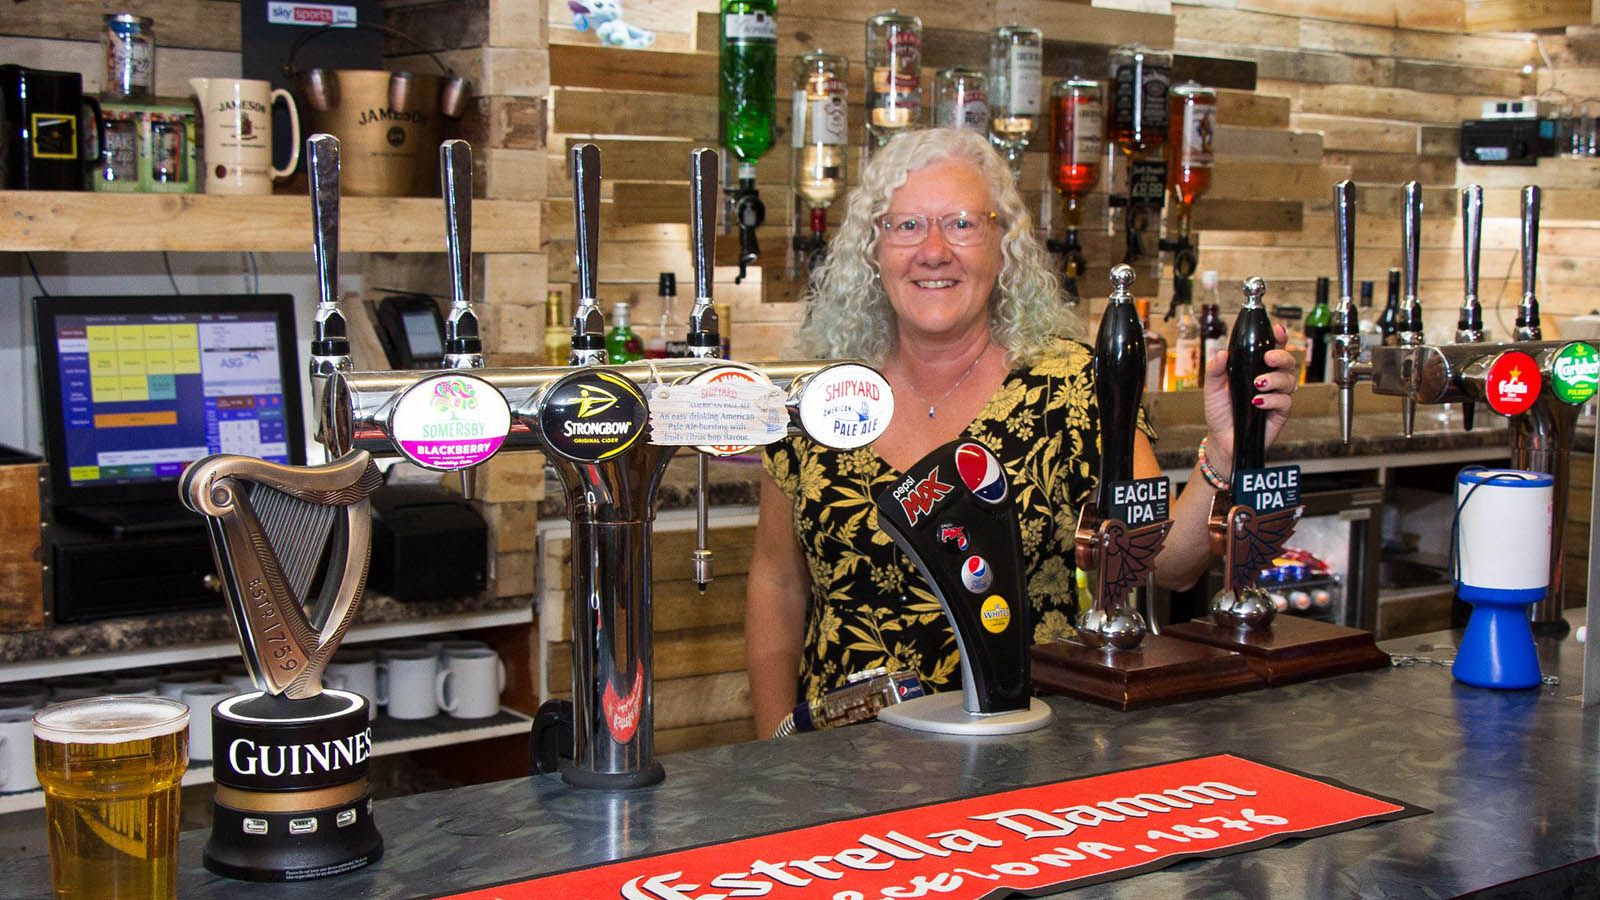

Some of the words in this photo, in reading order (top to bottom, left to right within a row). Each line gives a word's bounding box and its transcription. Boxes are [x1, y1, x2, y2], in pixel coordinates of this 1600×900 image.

[825, 380, 880, 402] SHIPYARD
[668, 423, 683, 431] Pale
[685, 423, 697, 431] Ale
[730, 423, 747, 431] with
[671, 414, 687, 422] easy
[688, 413, 719, 422] drinking
[833, 419, 858, 437] PALE
[861, 417, 879, 435] ALE
[422, 422, 485, 439] SOMERSBY
[417, 442, 491, 455] BLACKBERRY
[892, 475, 916, 501] pepsi
[1242, 470, 1298, 492] EAGLE
[900, 464, 955, 527] MAX
[1114, 480, 1168, 505] EAGLE
[1256, 491, 1285, 511] IPA
[1127, 503, 1155, 525] IPA
[263, 622, 298, 671] 1759
[619, 827, 1003, 900] Estrella
[966, 781, 1257, 841] Damm
